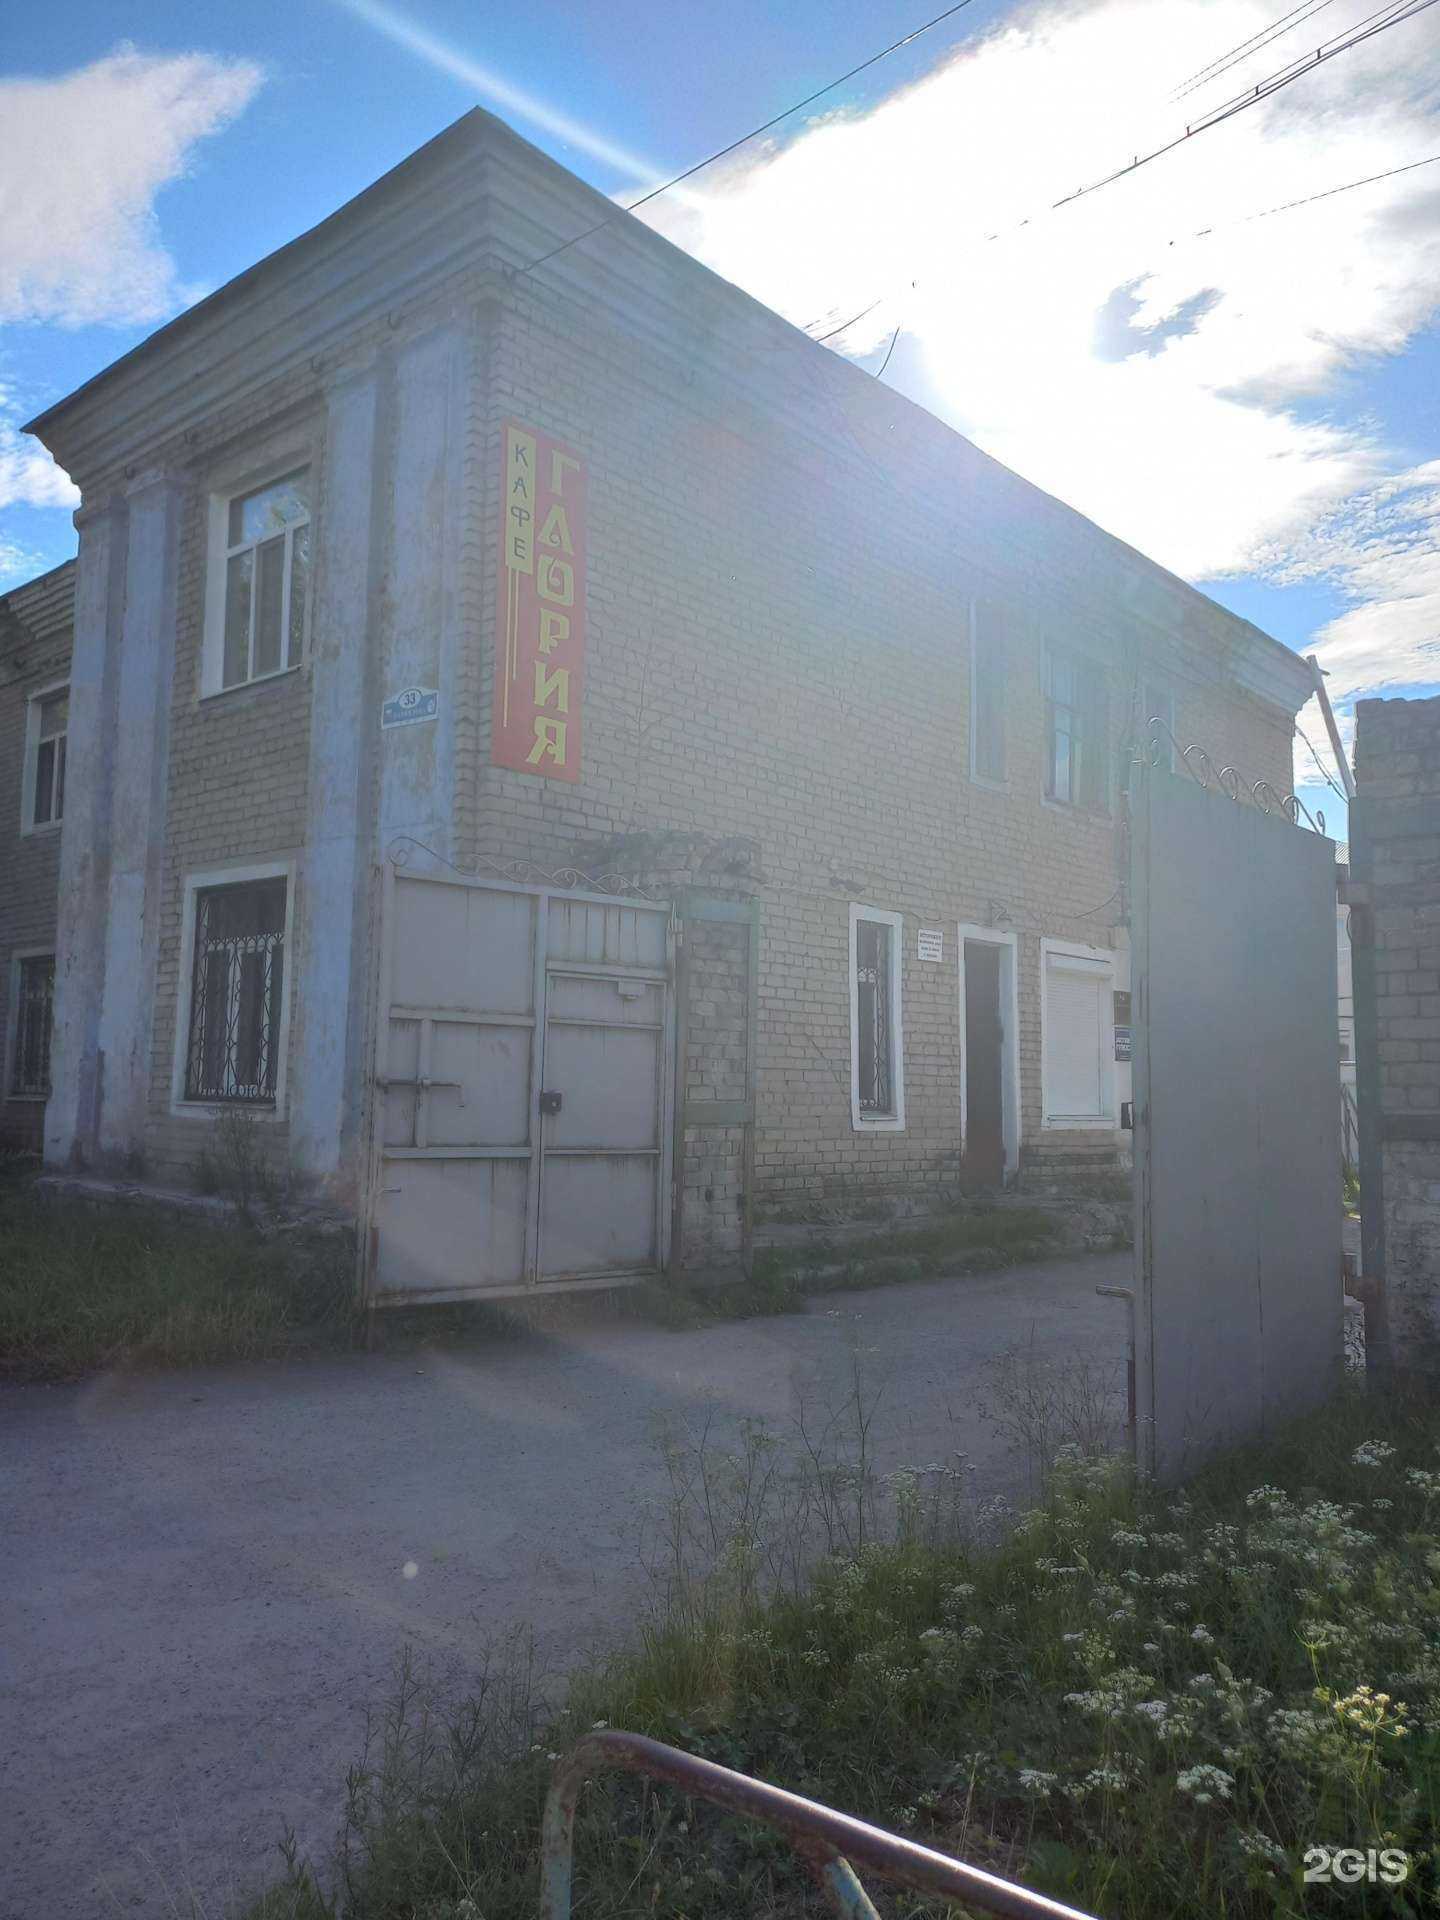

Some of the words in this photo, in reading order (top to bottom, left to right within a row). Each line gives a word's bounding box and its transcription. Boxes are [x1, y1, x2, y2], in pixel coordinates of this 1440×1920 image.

[510, 443, 531, 560] КАФЕ
[525, 449, 581, 766] ГЛОРИЯ
[403, 692, 416, 705] 33
